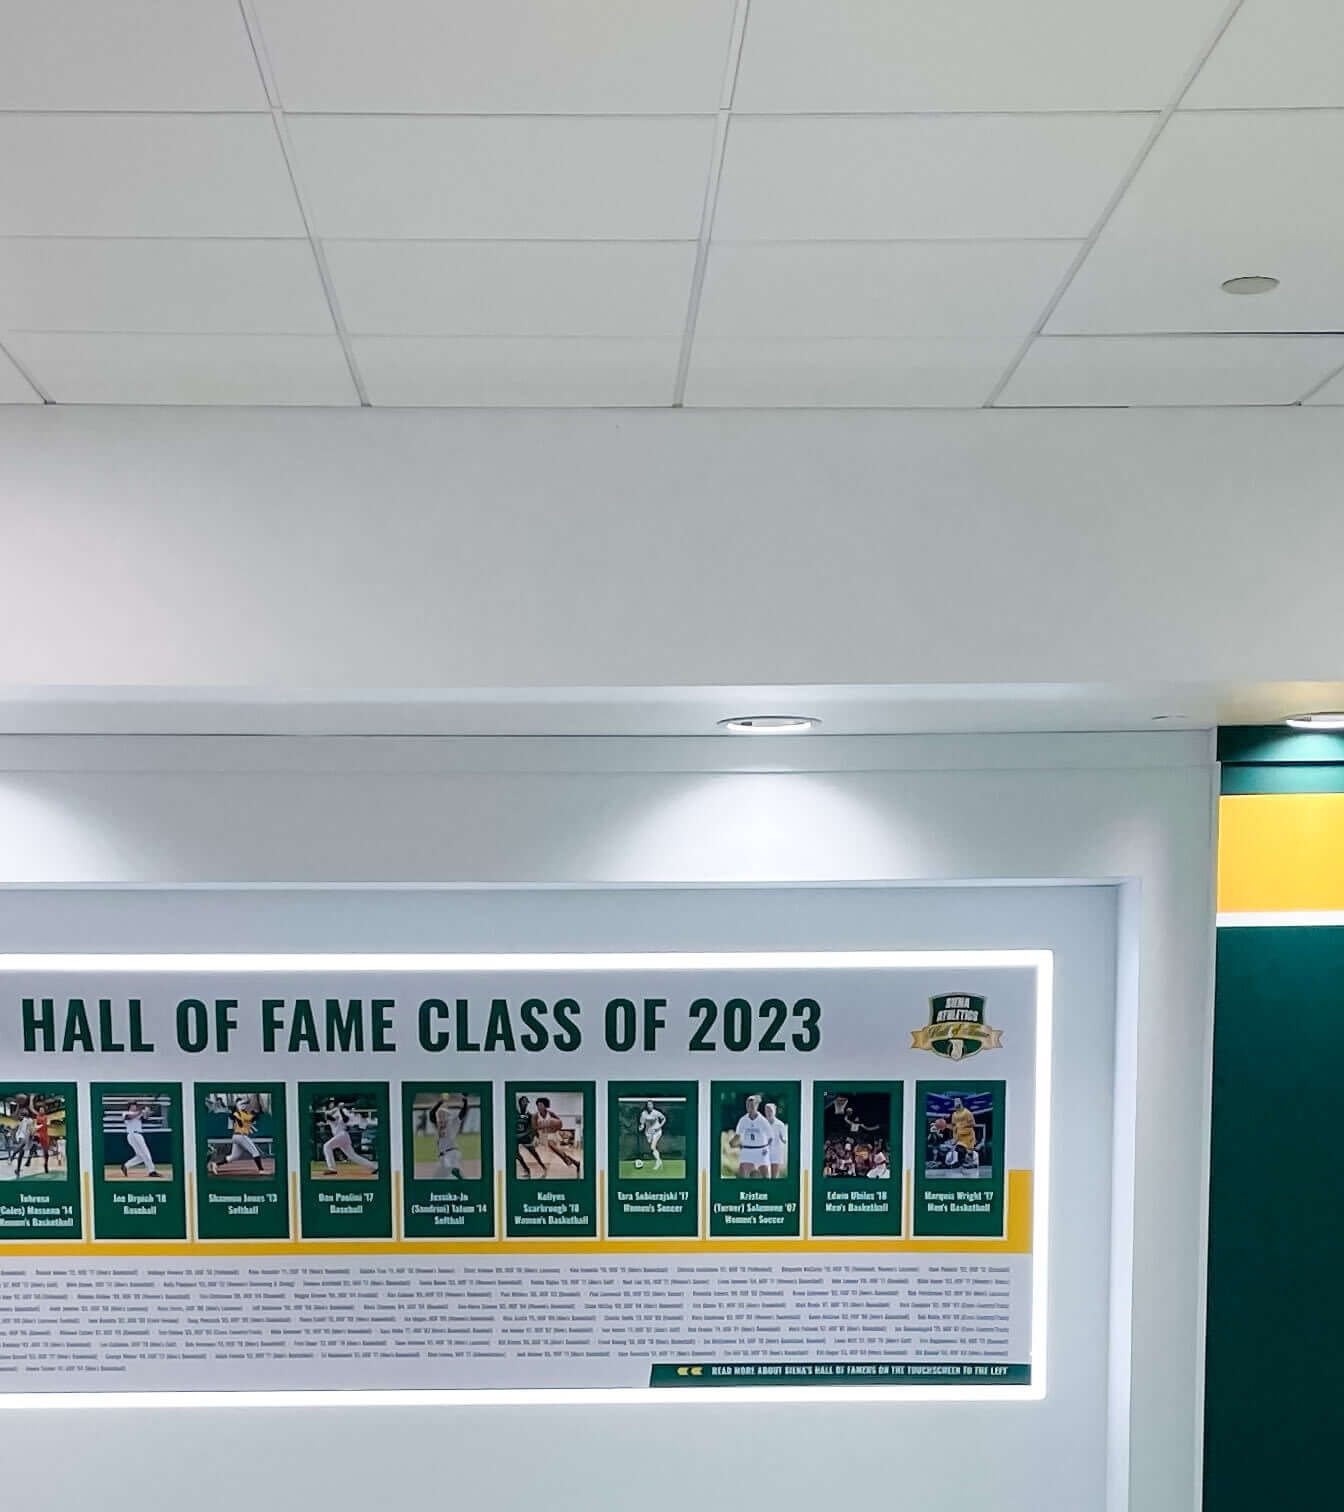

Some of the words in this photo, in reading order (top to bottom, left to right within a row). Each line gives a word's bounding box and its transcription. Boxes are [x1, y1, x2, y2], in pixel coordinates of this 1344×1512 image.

[22, 998, 154, 1052] HALL
[176, 998, 238, 1052] OF
[262, 998, 396, 1052] FAME
[418, 998, 582, 1052] CLASS
[604, 998, 666, 1052] OF
[688, 998, 821, 1052] 2023
[957, 1192, 981, 1201] Wright
[657, 1204, 682, 1212] Soccer
[759, 1215, 784, 1224] Soccer
